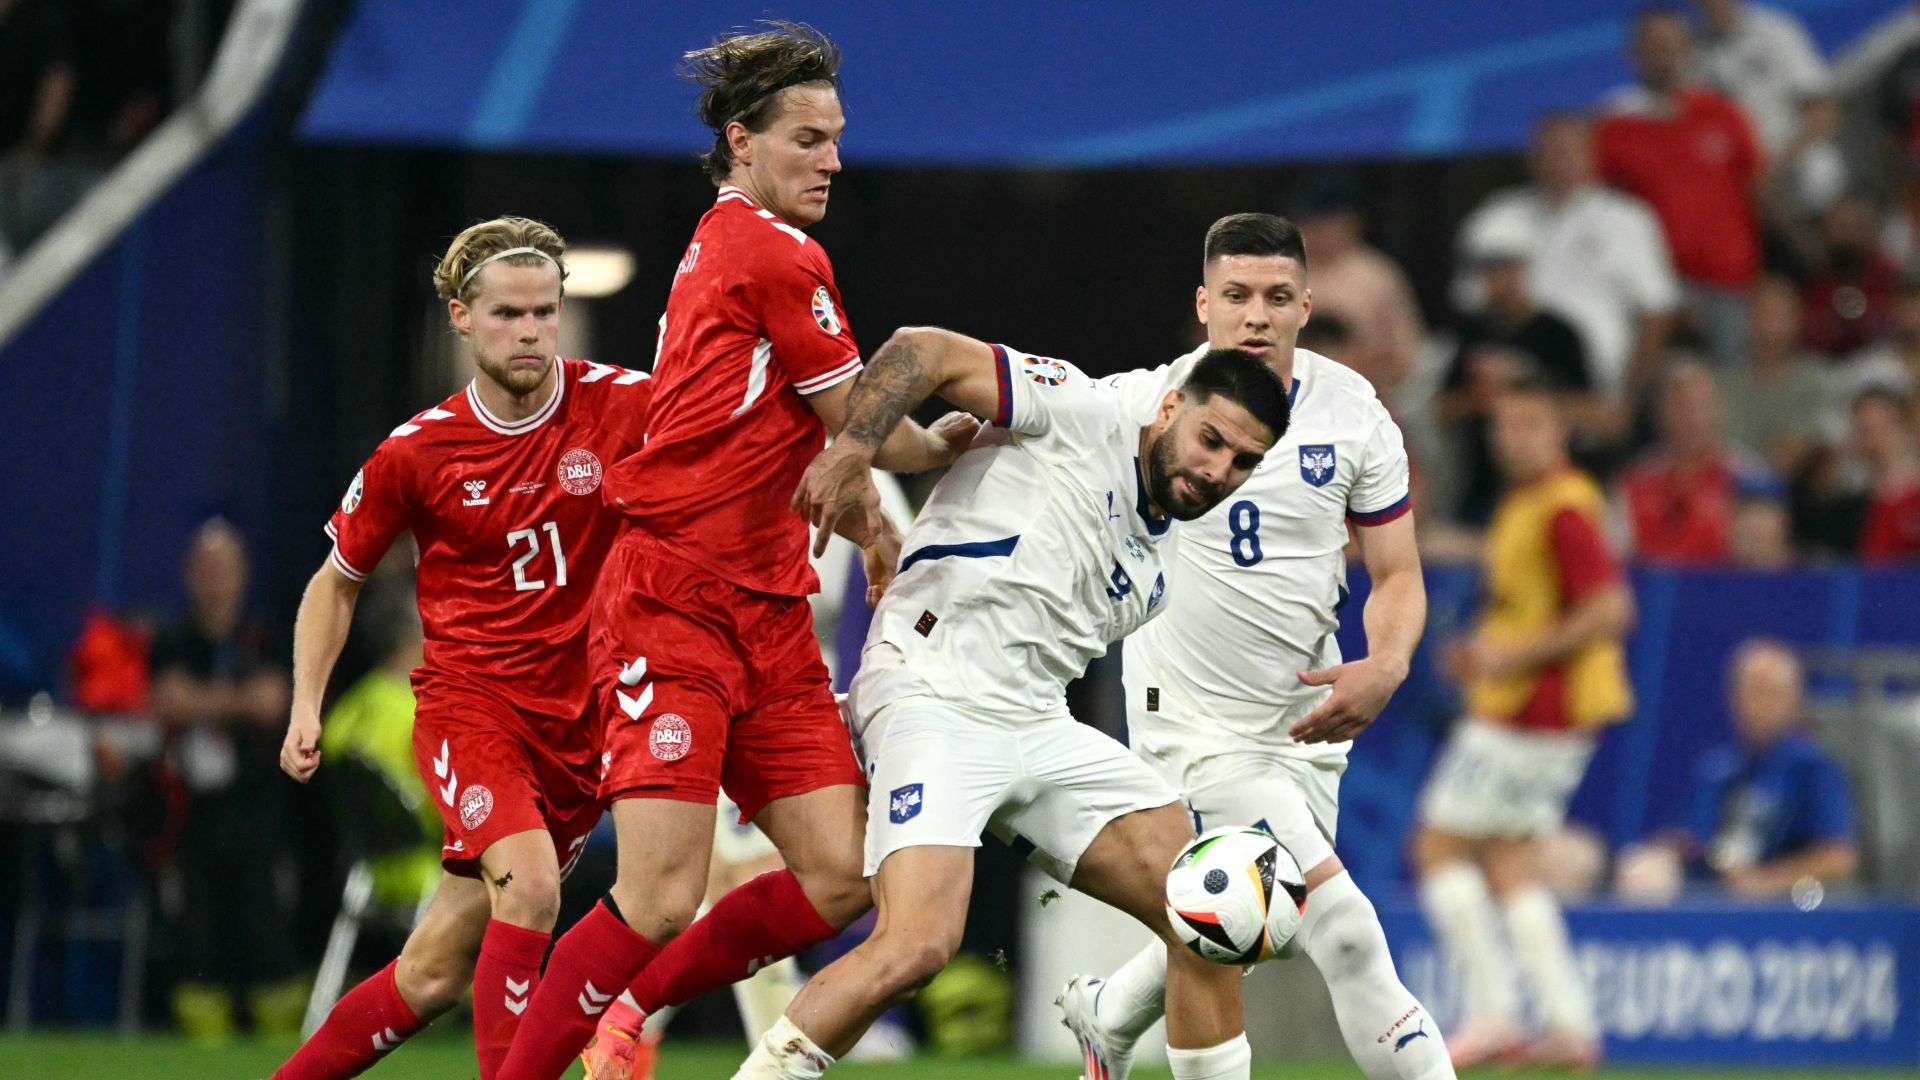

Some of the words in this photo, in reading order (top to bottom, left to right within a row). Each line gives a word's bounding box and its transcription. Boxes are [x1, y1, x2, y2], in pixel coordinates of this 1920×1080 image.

[567, 463, 593, 480] DBU
[1229, 500, 1263, 567] 8
[506, 521, 567, 592] 21
[656, 729, 682, 743] DBU
[464, 795, 484, 819] DBU
